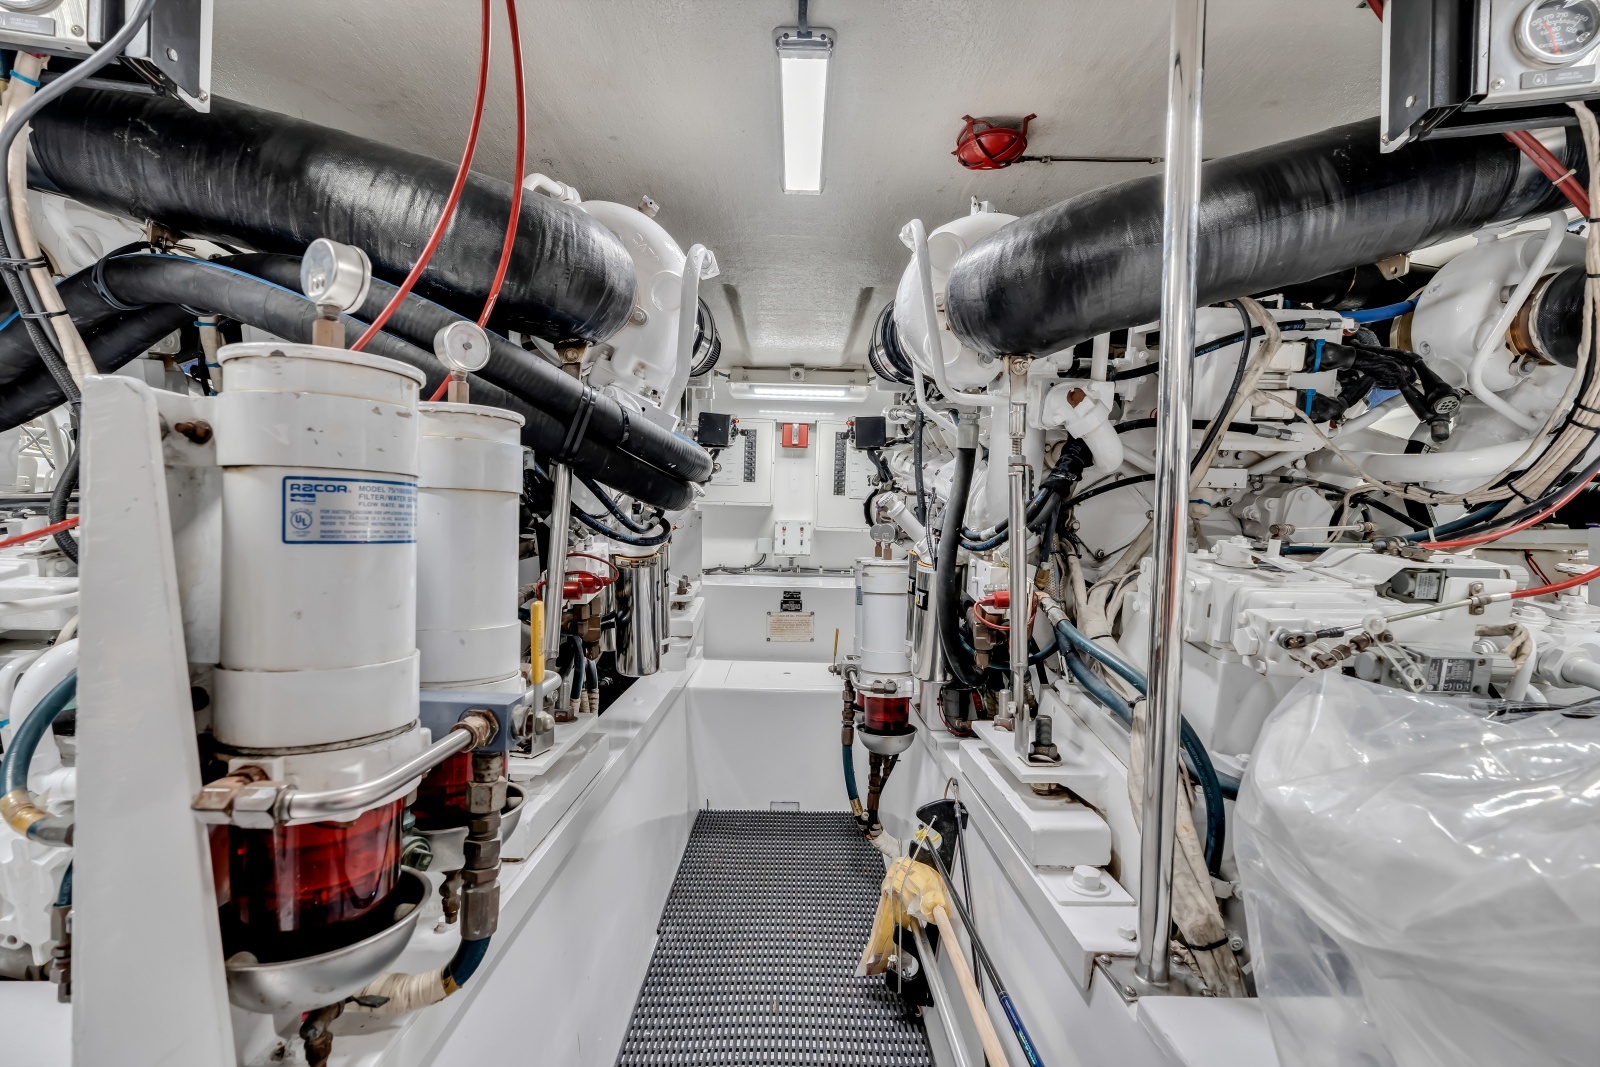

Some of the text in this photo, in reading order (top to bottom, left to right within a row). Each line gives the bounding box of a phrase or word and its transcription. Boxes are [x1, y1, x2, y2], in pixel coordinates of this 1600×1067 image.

[290, 484, 347, 493] RACOR
[358, 485, 386, 493] MODEL
[358, 494, 406, 502] FILTER/WATER
[295, 514, 308, 526] UL
